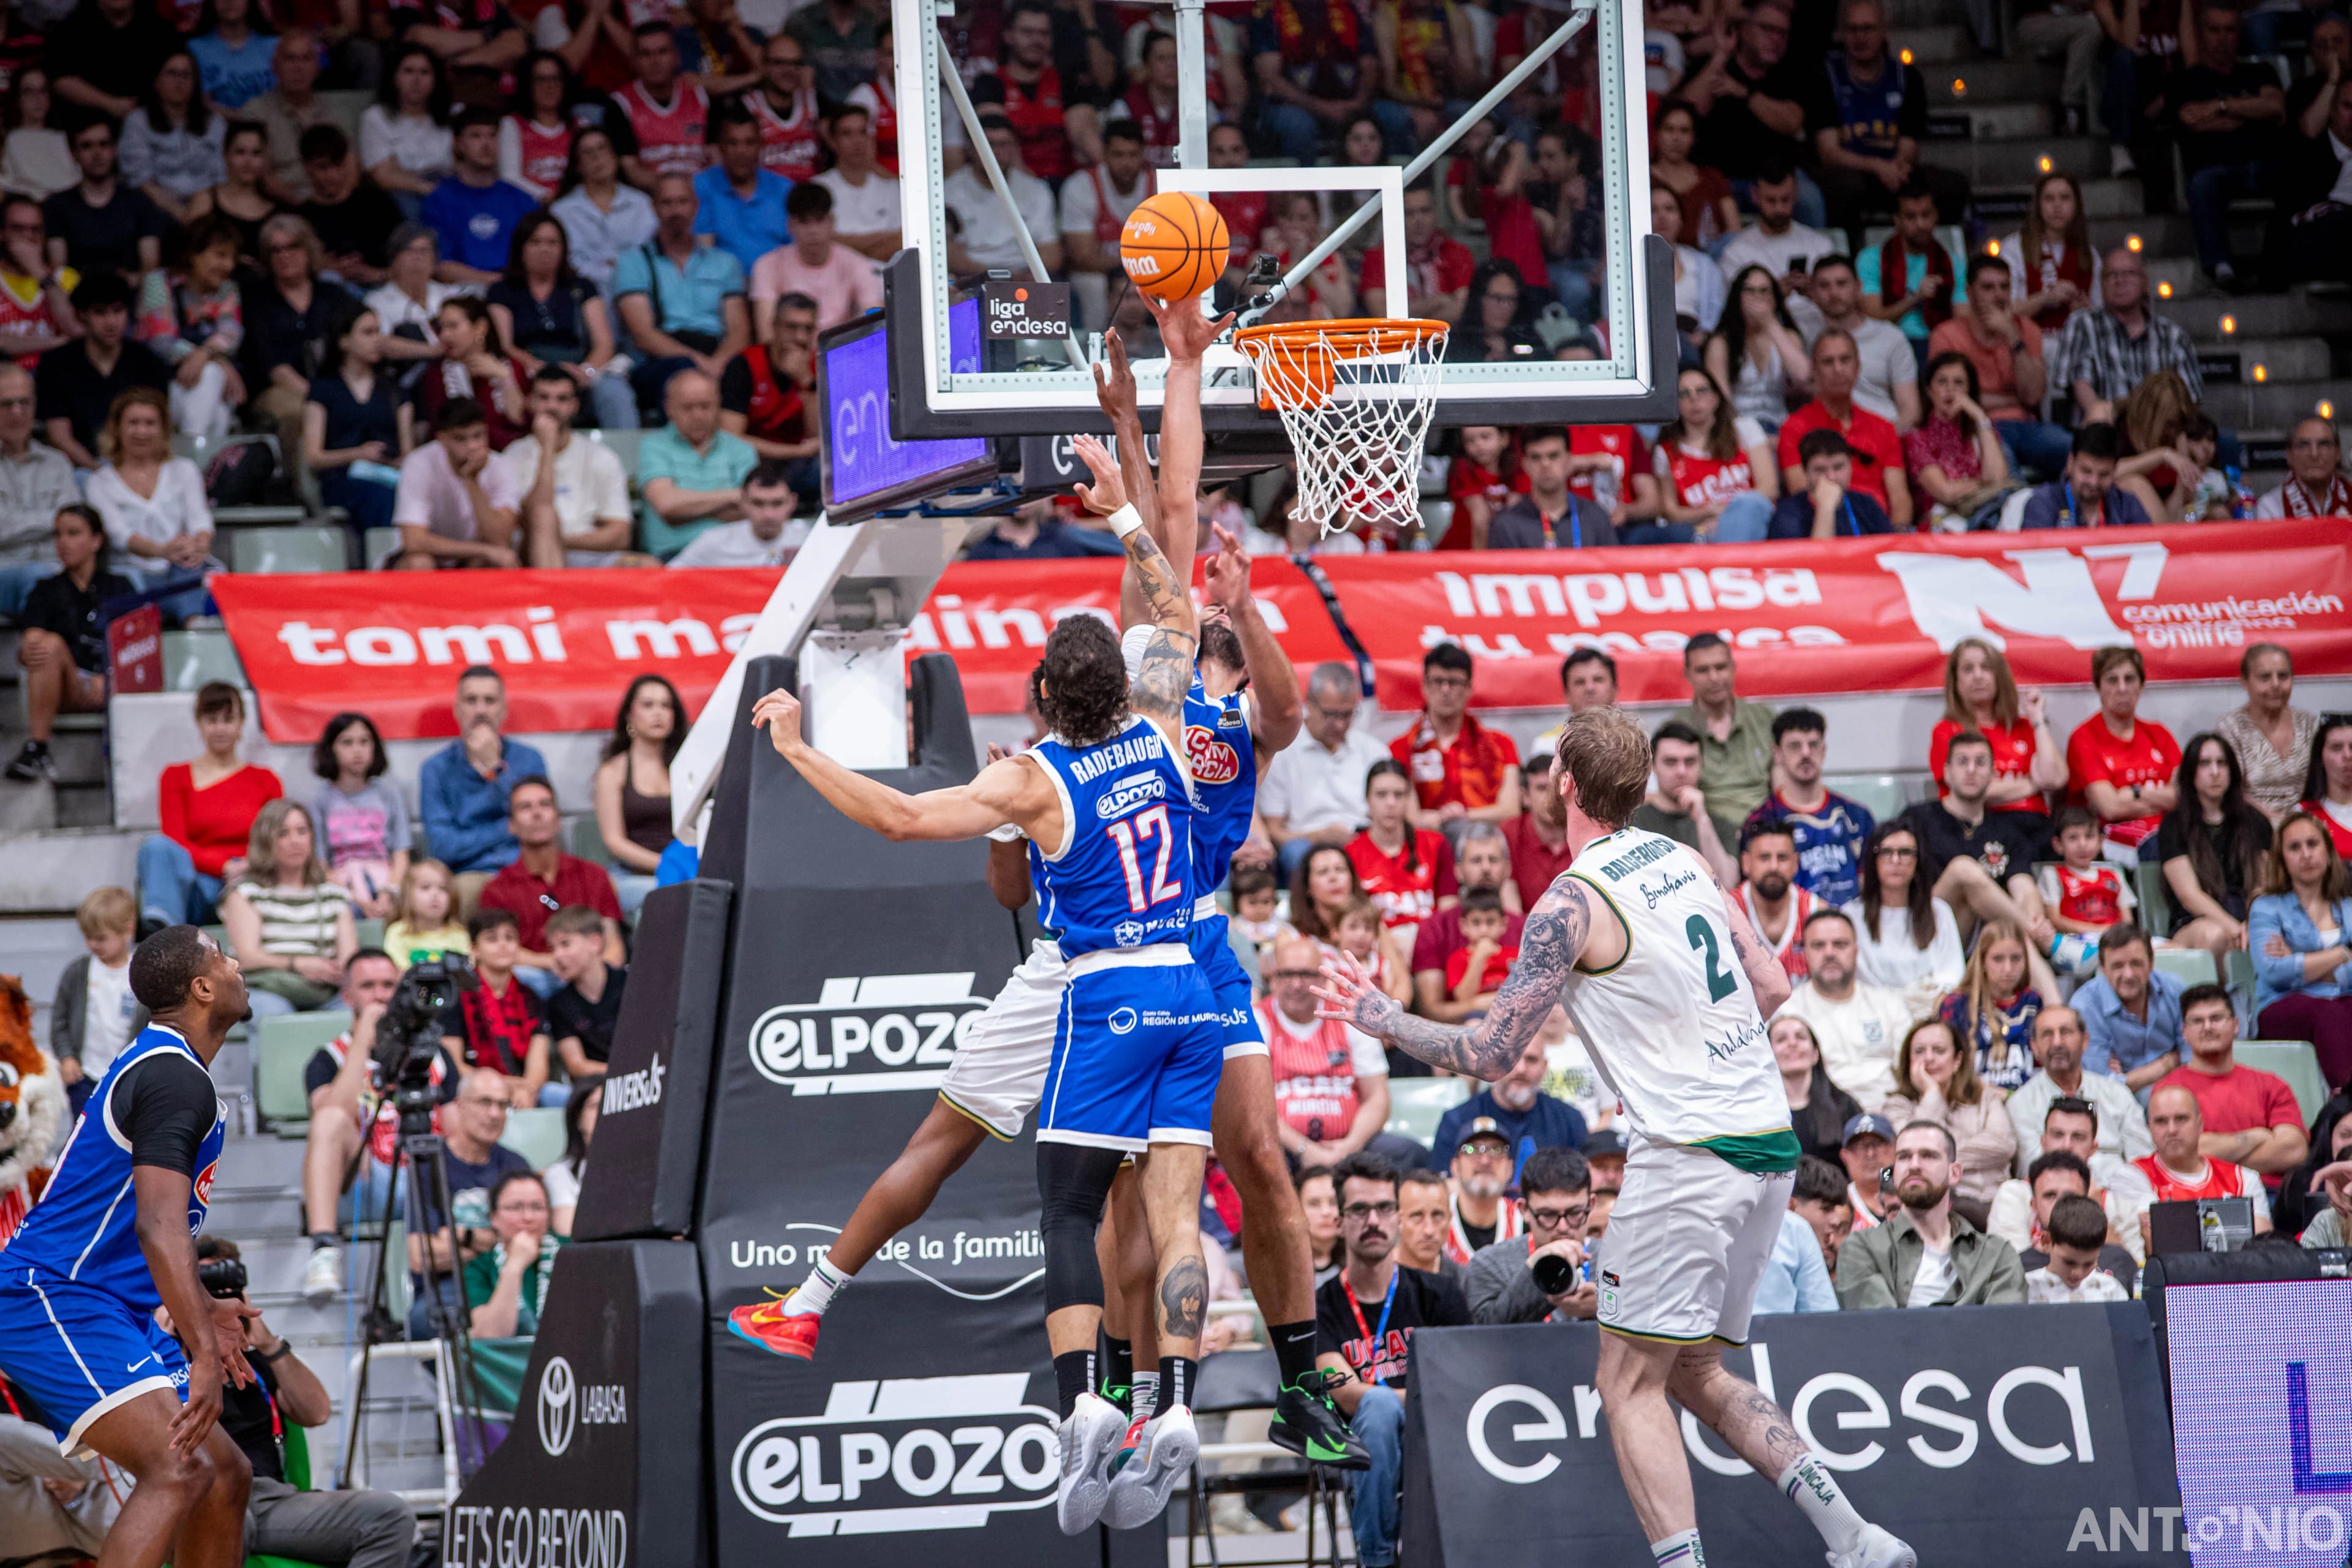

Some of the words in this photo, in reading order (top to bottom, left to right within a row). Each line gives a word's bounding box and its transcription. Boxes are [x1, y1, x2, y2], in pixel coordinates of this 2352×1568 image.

[990, 299, 1025, 318] liga
[990, 317, 1067, 335] endesa
[2121, 590, 2345, 624] comunicación
[277, 605, 567, 666] tomi
[1069, 734, 1164, 785] RADEBAUGH
[1106, 803, 1182, 913] 12
[1686, 914, 1738, 1005] 2
[1142, 1015, 1176, 1026] REGIÓN
[1178, 1016, 1189, 1025] DE
[1191, 1012, 1221, 1023] MURCIA
[731, 1240, 797, 1268] Uno
[876, 1237, 910, 1262] de
[919, 1235, 944, 1260] la
[1603, 1275, 1616, 1285] acb
[582, 1385, 627, 1424] LABASA
[1798, 1464, 1836, 1507] UNICAJA
[443, 1506, 494, 1568] LET'S
[497, 1507, 533, 1568] GO
[537, 1508, 627, 1568] BEYOND
[1691, 1539, 1706, 1568] UNICA
